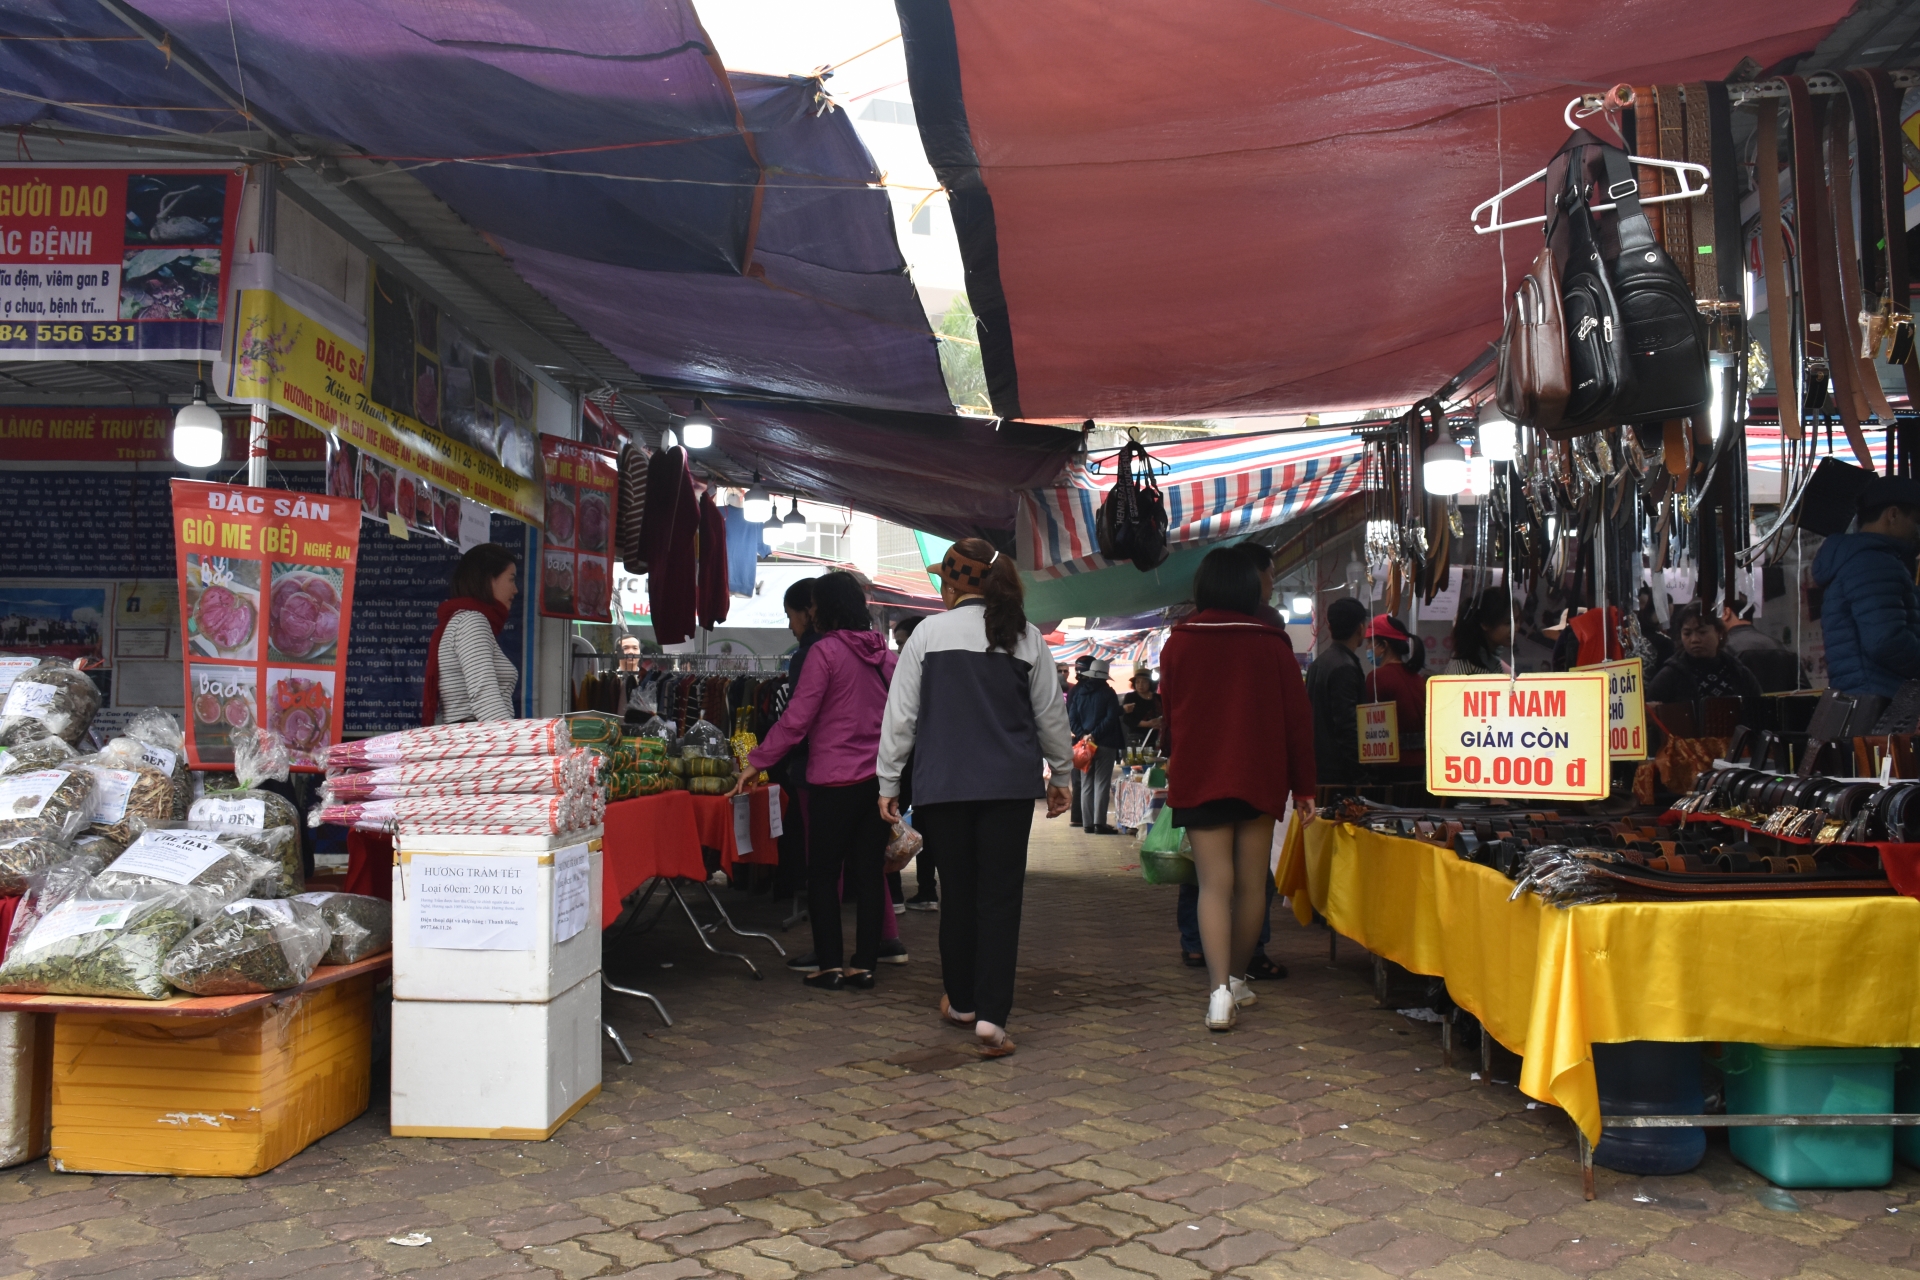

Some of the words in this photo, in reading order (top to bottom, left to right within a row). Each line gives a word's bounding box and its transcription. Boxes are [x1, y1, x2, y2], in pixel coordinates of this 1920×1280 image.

[60, 185, 108, 217] DAO
[30, 226, 92, 260] BỆNH
[15, 270, 42, 290] đệm,
[46, 270, 73, 286] viêm
[77, 275, 98, 290] gan
[102, 270, 110, 286] B
[16, 298, 46, 314] chua,
[50, 298, 77, 318] bệnh
[37, 325, 84, 342] 556
[92, 325, 136, 342] 531
[316, 338, 346, 372] ĐẶC
[0, 414, 44, 438] LÀNG
[48, 413, 96, 438] NGHỀ
[101, 413, 166, 438] TRUYỀN
[284, 382, 312, 412] HƯƠNG
[340, 412, 349, 432] VÀ
[366, 427, 378, 447] ME
[401, 446, 411, 462] AN
[325, 376, 351, 406] Hiệu
[355, 393, 388, 424] Thanh
[422, 429, 440, 450] 0977
[442, 441, 452, 458] 66
[454, 446, 461, 462] 11
[463, 452, 472, 468] 26
[478, 460, 494, 479] 0979
[495, 469, 504, 485] 96
[504, 475, 520, 492] 8615
[275, 448, 296, 458] Ba
[560, 461, 572, 480] ME
[208, 490, 265, 516] ĐẶC
[273, 496, 330, 522] SẢN
[182, 514, 215, 546] GIÒ
[221, 522, 252, 550] ME
[259, 523, 298, 558] (BÊ)
[303, 541, 332, 560] NGHỆ
[334, 546, 350, 560] AN
[413, 600, 439, 608] trong
[1620, 668, 1636, 694] CẮT
[1373, 710, 1386, 724] NAM
[1463, 690, 1500, 723] NỊT
[1508, 690, 1566, 718] NAM
[1610, 696, 1624, 720] HỖ
[1362, 742, 1386, 756] 50.000
[1388, 742, 1394, 756] đ
[1460, 726, 1514, 748] GIẢM
[1520, 727, 1569, 749] CÒN
[1610, 727, 1628, 750] 00
[1632, 726, 1640, 749] đ
[1444, 756, 1554, 786] 50.000
[1566, 758, 1587, 787] đ
[424, 866, 464, 876] HƯƠNG
[422, 884, 441, 894] Loại
[444, 884, 470, 894] 60cm:
[474, 885, 490, 894] 200
[493, 886, 508, 894] K/1
[512, 886, 522, 894] bó
